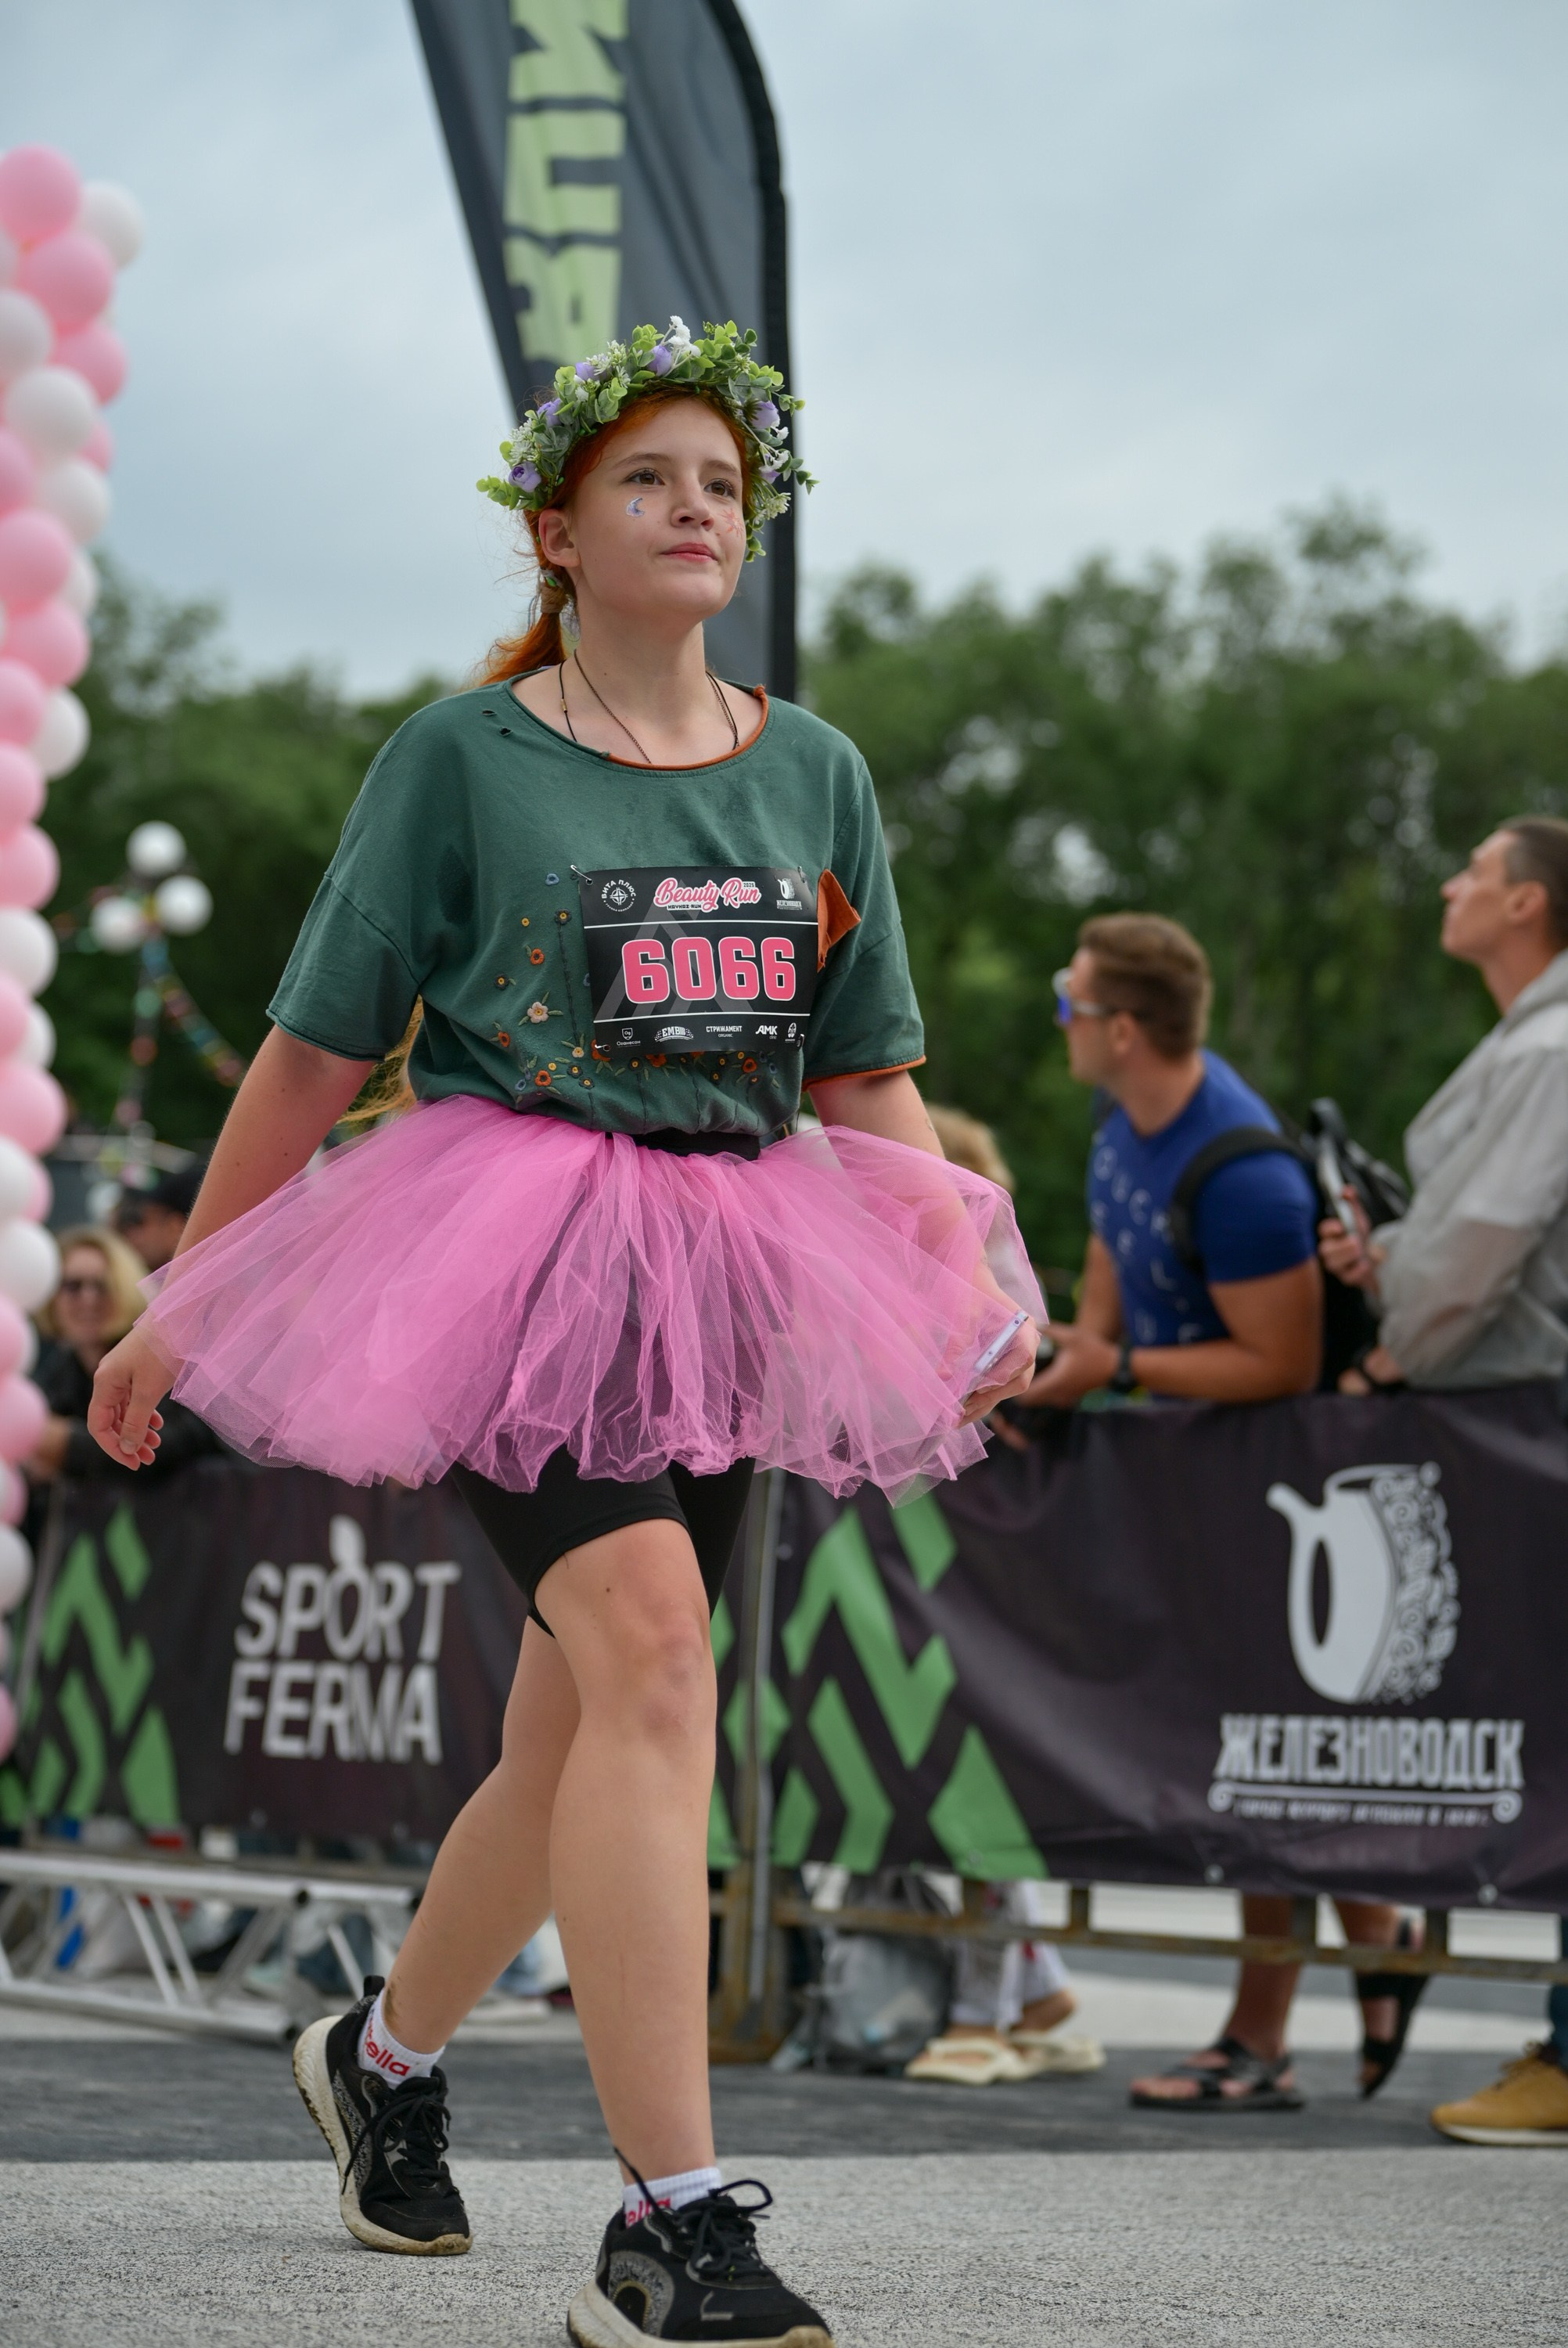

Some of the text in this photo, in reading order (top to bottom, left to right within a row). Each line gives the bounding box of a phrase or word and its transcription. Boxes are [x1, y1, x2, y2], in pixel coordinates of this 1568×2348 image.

[602, 880, 636, 899] ВИТА ПЛЮС
[653, 877, 761, 913] Beauty Run
[621, 936, 796, 1004] 6066
[234, 1560, 462, 1663] SPORT
[222, 1658, 444, 1766] FERMA
[1213, 1713, 1525, 1790] ЖЕЛЕЗНОВОДСК
